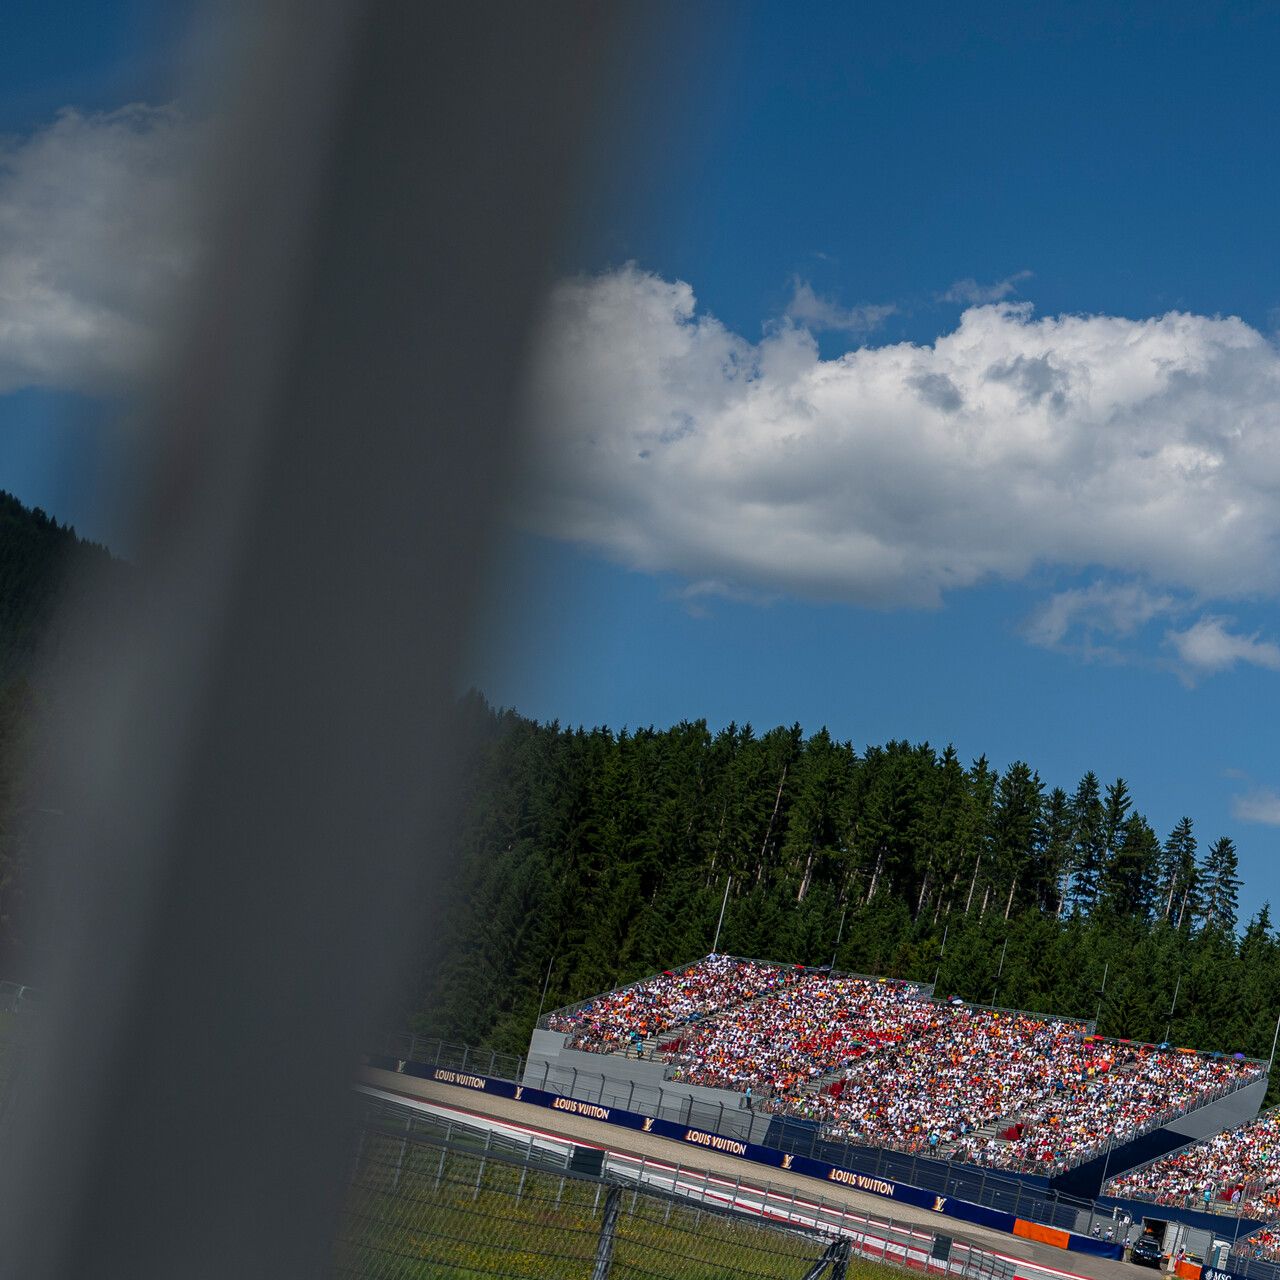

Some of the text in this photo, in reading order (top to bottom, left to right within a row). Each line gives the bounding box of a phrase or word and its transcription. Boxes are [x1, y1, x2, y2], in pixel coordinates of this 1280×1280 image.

[435, 1069, 485, 1088] LOUIS VUITTON
[554, 1098, 609, 1119] LOUIS VUITTON
[686, 1130, 747, 1155] LOUIS VUITTON
[830, 1169, 894, 1196] LOUIS VUITTON
